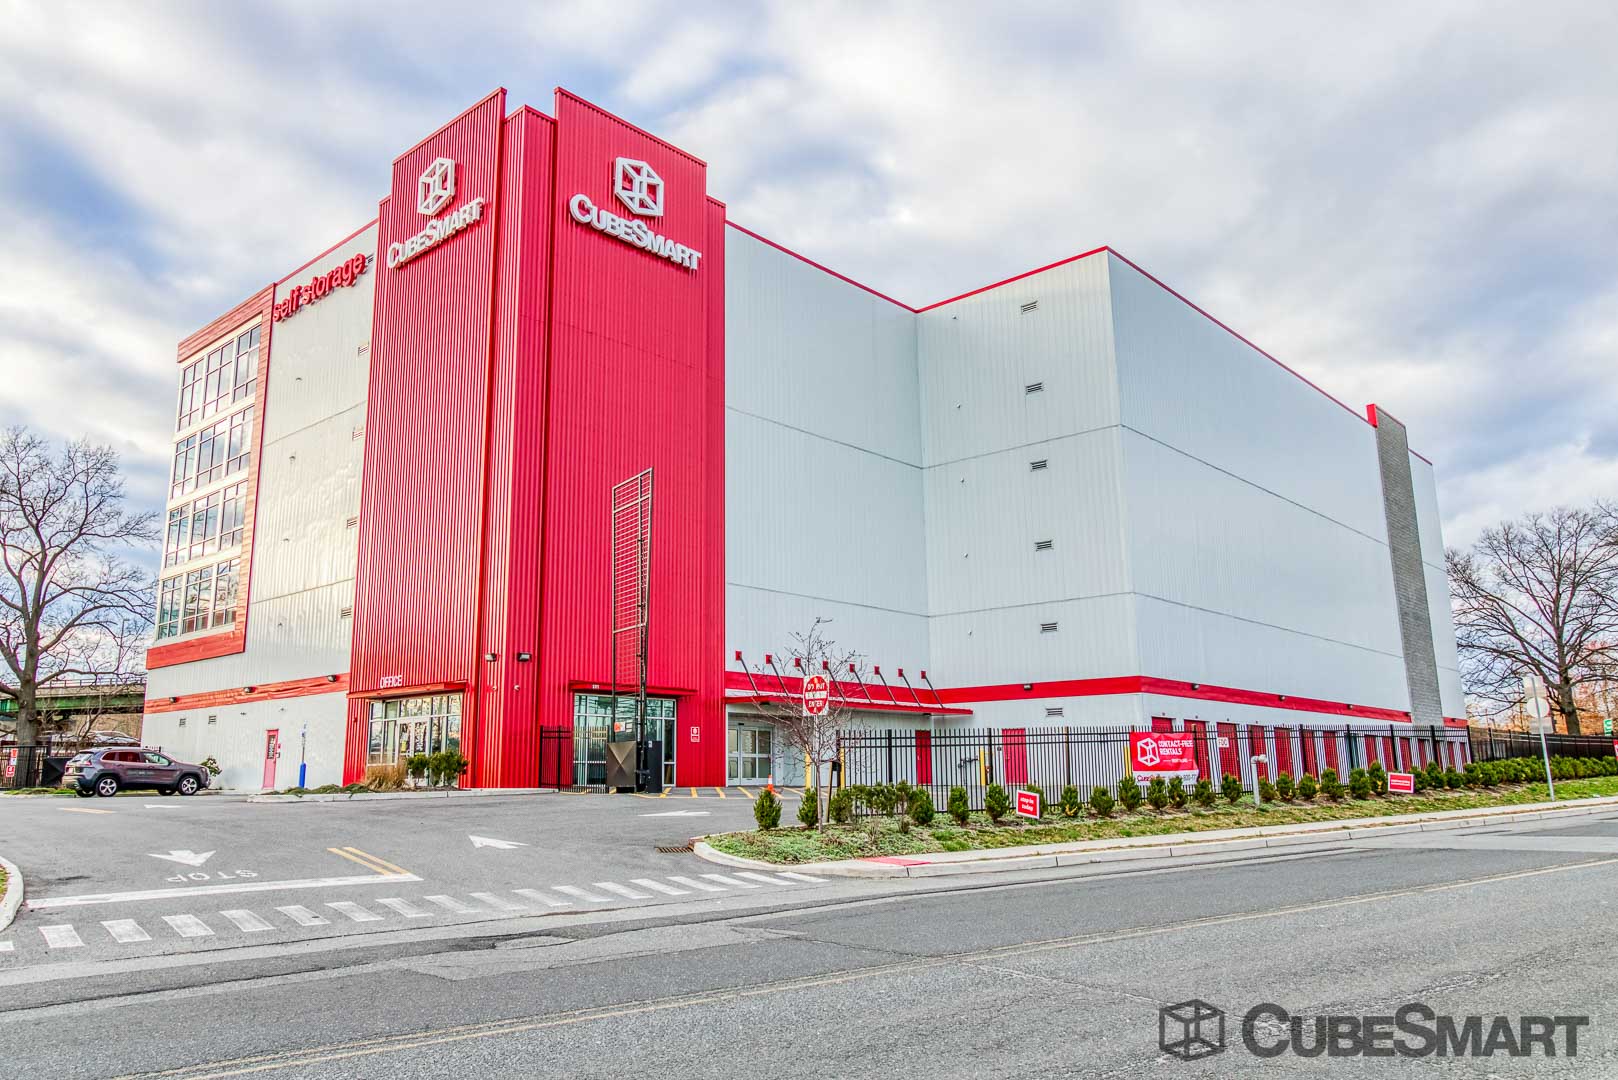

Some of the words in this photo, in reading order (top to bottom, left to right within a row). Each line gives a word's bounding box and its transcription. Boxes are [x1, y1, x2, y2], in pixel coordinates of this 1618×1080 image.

[387, 197, 483, 268] CUBESMART
[569, 194, 702, 270] CUBESMART
[272, 285, 302, 322] self
[302, 253, 366, 305] storage
[380, 674, 402, 689] OFFICE
[1158, 739, 1194, 748] CONTACT-FREE
[166, 869, 259, 882] STOP
